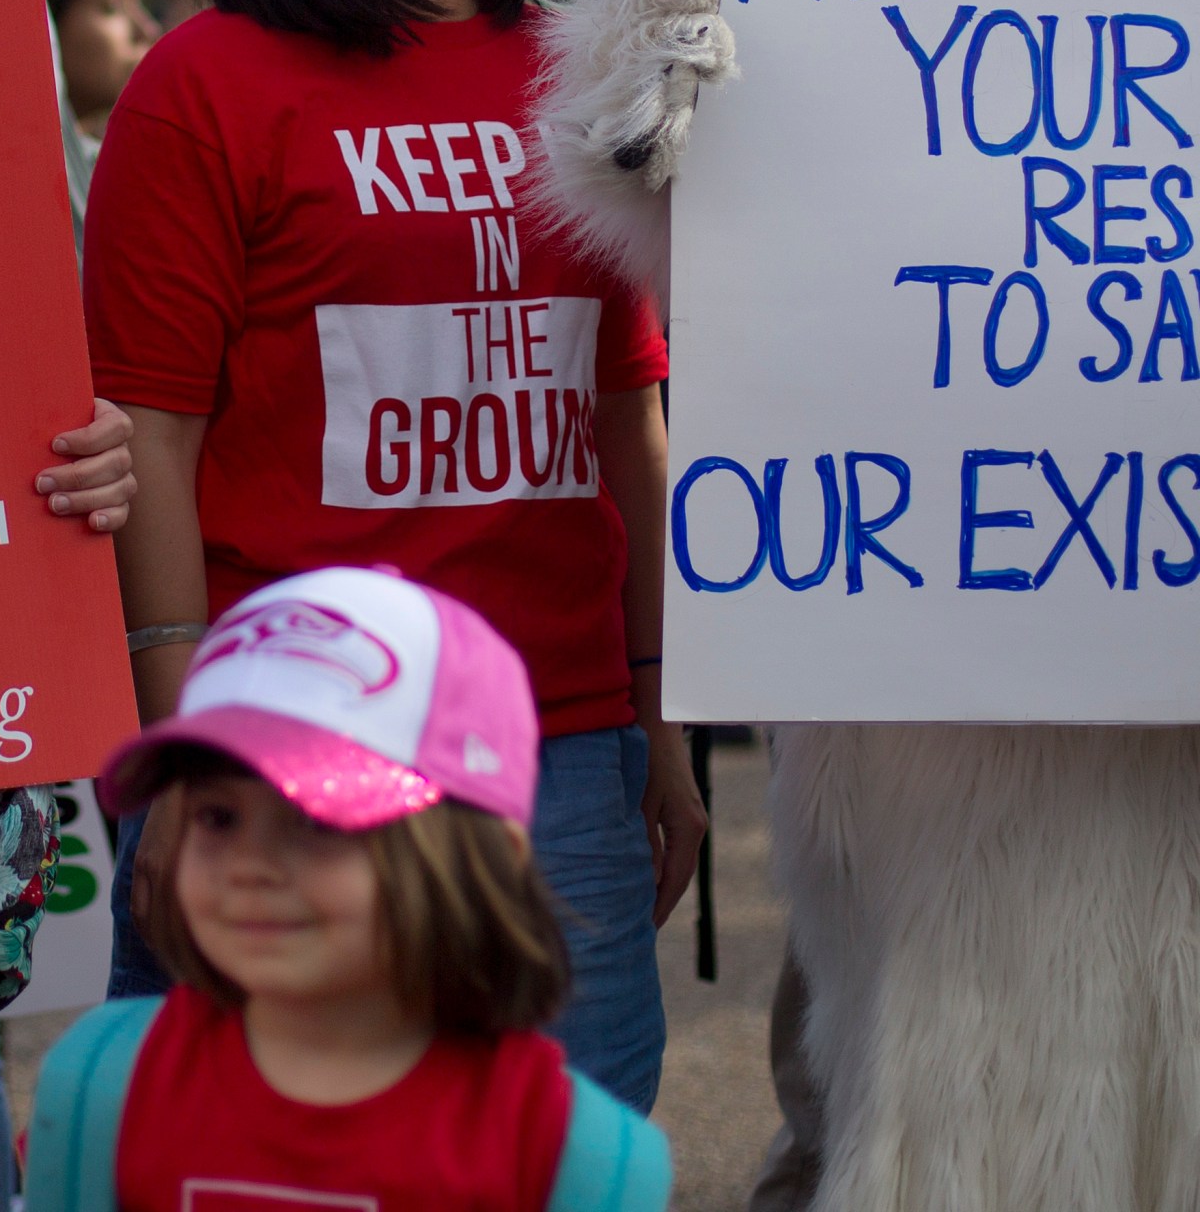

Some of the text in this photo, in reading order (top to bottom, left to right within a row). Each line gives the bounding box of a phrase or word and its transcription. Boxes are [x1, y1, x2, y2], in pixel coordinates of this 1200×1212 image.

[880, 4, 1195, 158] YOUR
[333, 120, 526, 215] KEEP
[1020, 155, 1195, 268] RES
[469, 215, 520, 292] IN
[452, 303, 553, 383] THE
[894, 264, 1200, 389] TO SA
[365, 388, 600, 496] GROUN
[670, 448, 1200, 596] OUR EXIS
